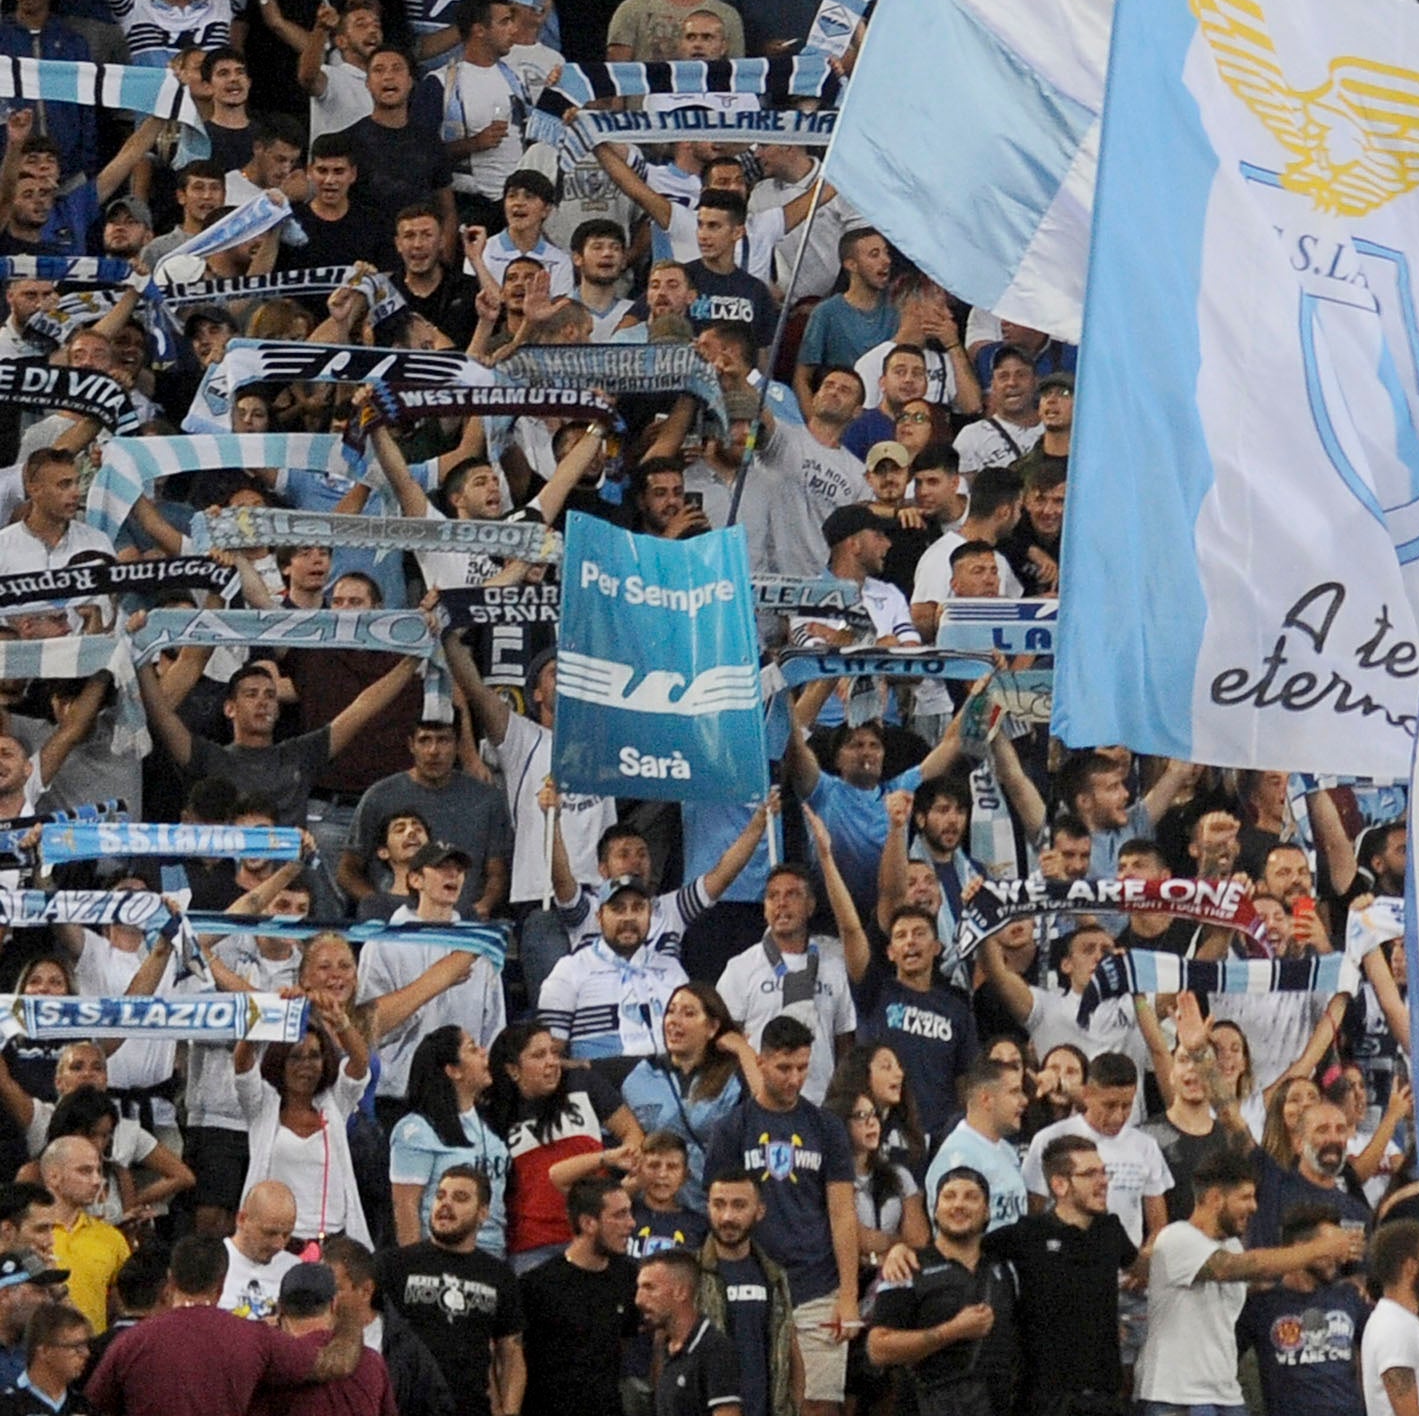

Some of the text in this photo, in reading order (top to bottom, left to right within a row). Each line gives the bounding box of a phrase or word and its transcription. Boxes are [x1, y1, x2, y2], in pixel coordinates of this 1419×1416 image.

[660, 110, 787, 134] MOLLARE
[710, 302, 754, 324] LAZIO
[22, 367, 60, 393] DI
[69, 369, 124, 409] VITA
[399, 387, 470, 408] WEST
[472, 386, 532, 406] HAM
[439, 519, 526, 545] 1900
[580, 559, 737, 619] Per Sempre
[618, 745, 691, 781] Sarà
[8, 889, 162, 926] LAZIO
[982, 877, 1248, 913] WE ARE ONE
[119, 1001, 238, 1028] LAZIO
[901, 1010, 953, 1042] LAZIO
